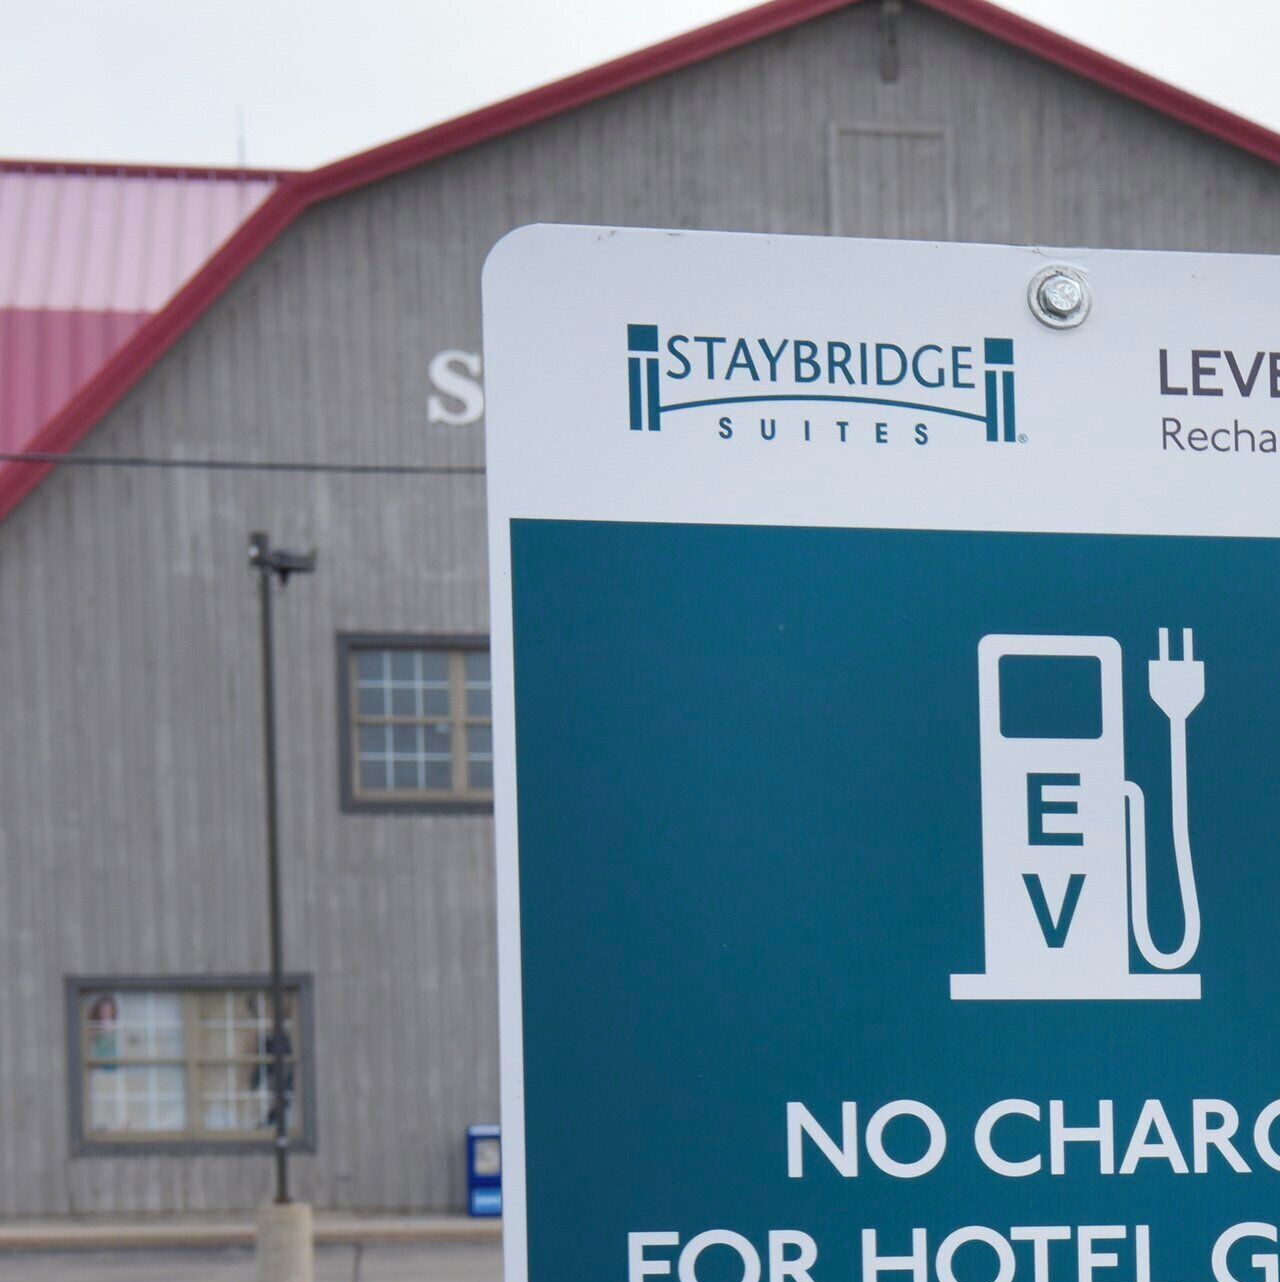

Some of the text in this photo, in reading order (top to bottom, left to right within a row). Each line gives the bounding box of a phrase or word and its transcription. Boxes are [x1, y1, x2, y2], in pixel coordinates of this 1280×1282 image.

[666, 335, 976, 390] STAYBRIDGE
[717, 416, 930, 446] SUITES
[785, 1099, 948, 1180] NO
